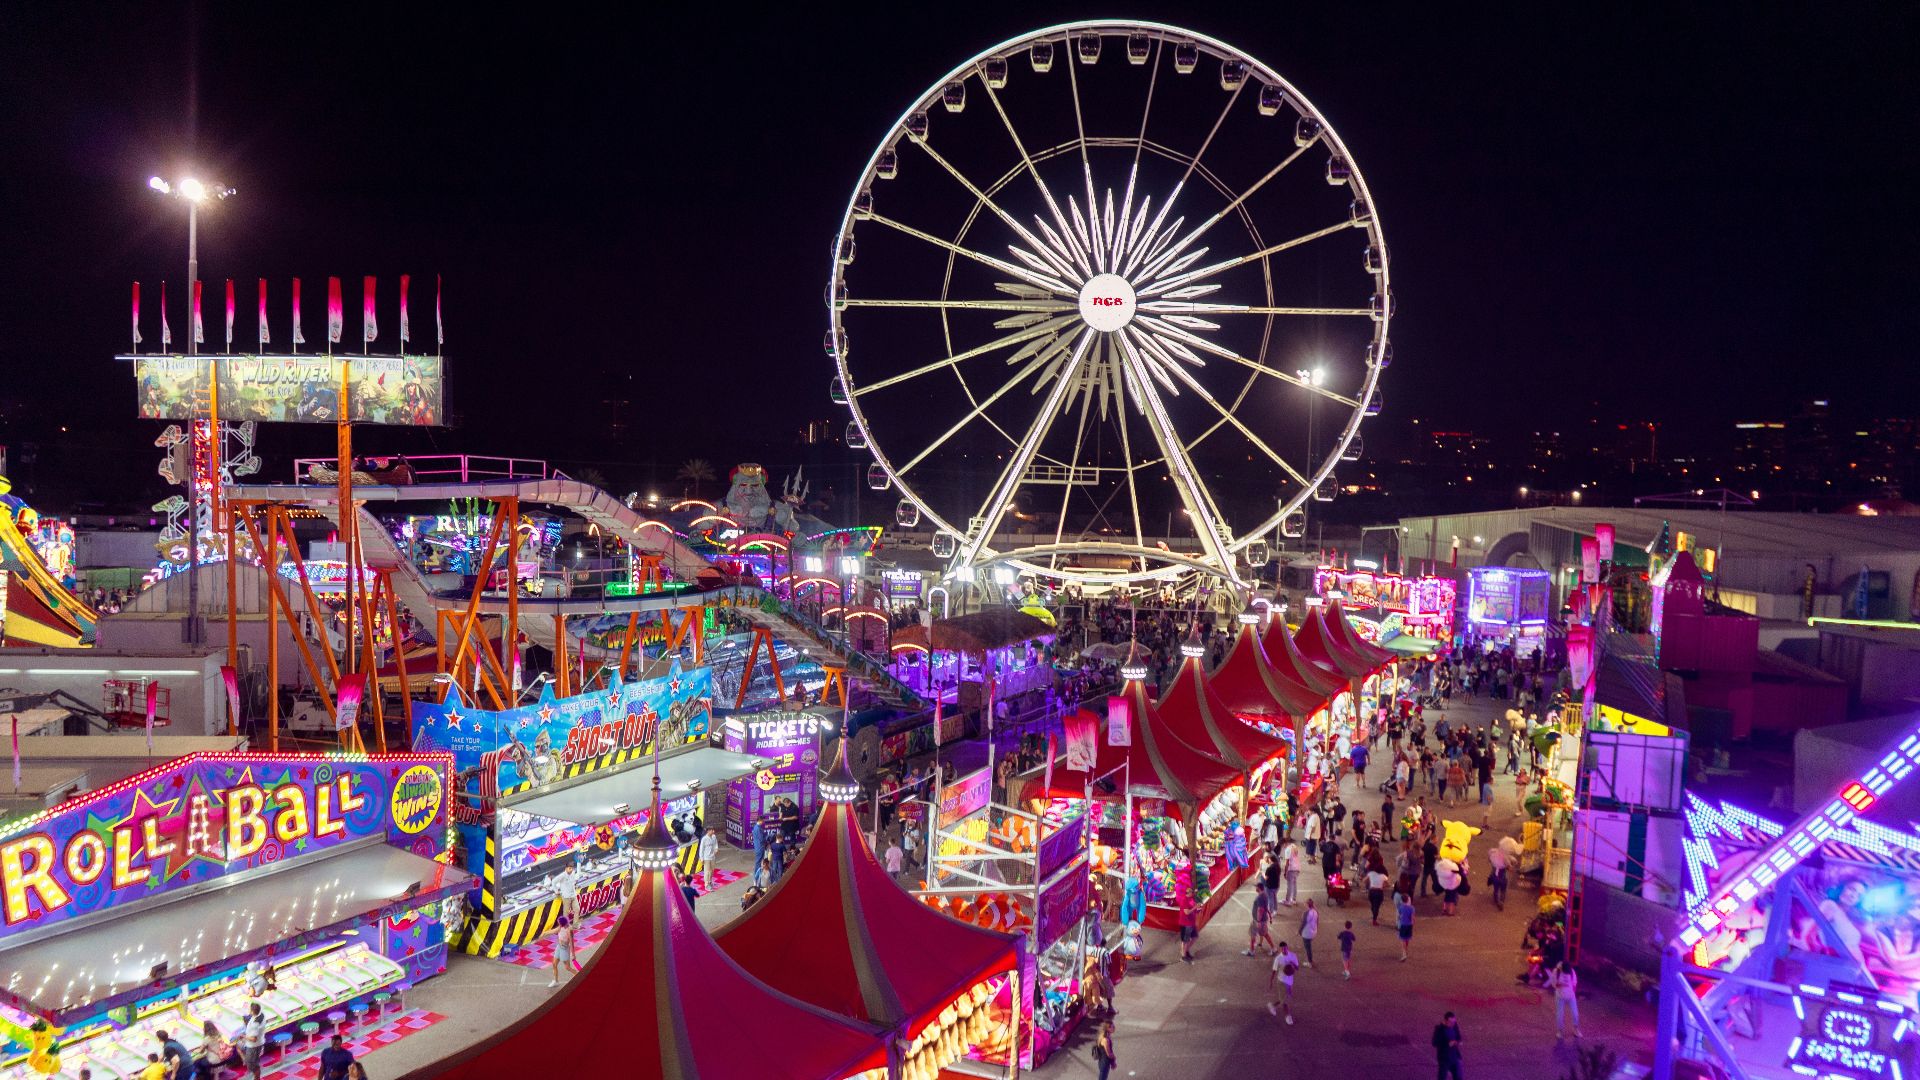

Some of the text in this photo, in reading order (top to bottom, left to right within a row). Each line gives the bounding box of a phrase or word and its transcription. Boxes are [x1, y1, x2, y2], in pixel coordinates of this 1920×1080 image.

[243, 363, 330, 385] WILD RIVER
[562, 702, 579, 713] TAKE
[580, 698, 599, 709] YOUR
[629, 688, 645, 699] BEST
[451, 736, 481, 744] TAKE YOUR
[565, 711, 657, 766] SHOOT OUT
[748, 718, 818, 740] TICKETS
[396, 787, 440, 825] WINS
[186, 793, 212, 858] A
[577, 880, 621, 917] HOOT
